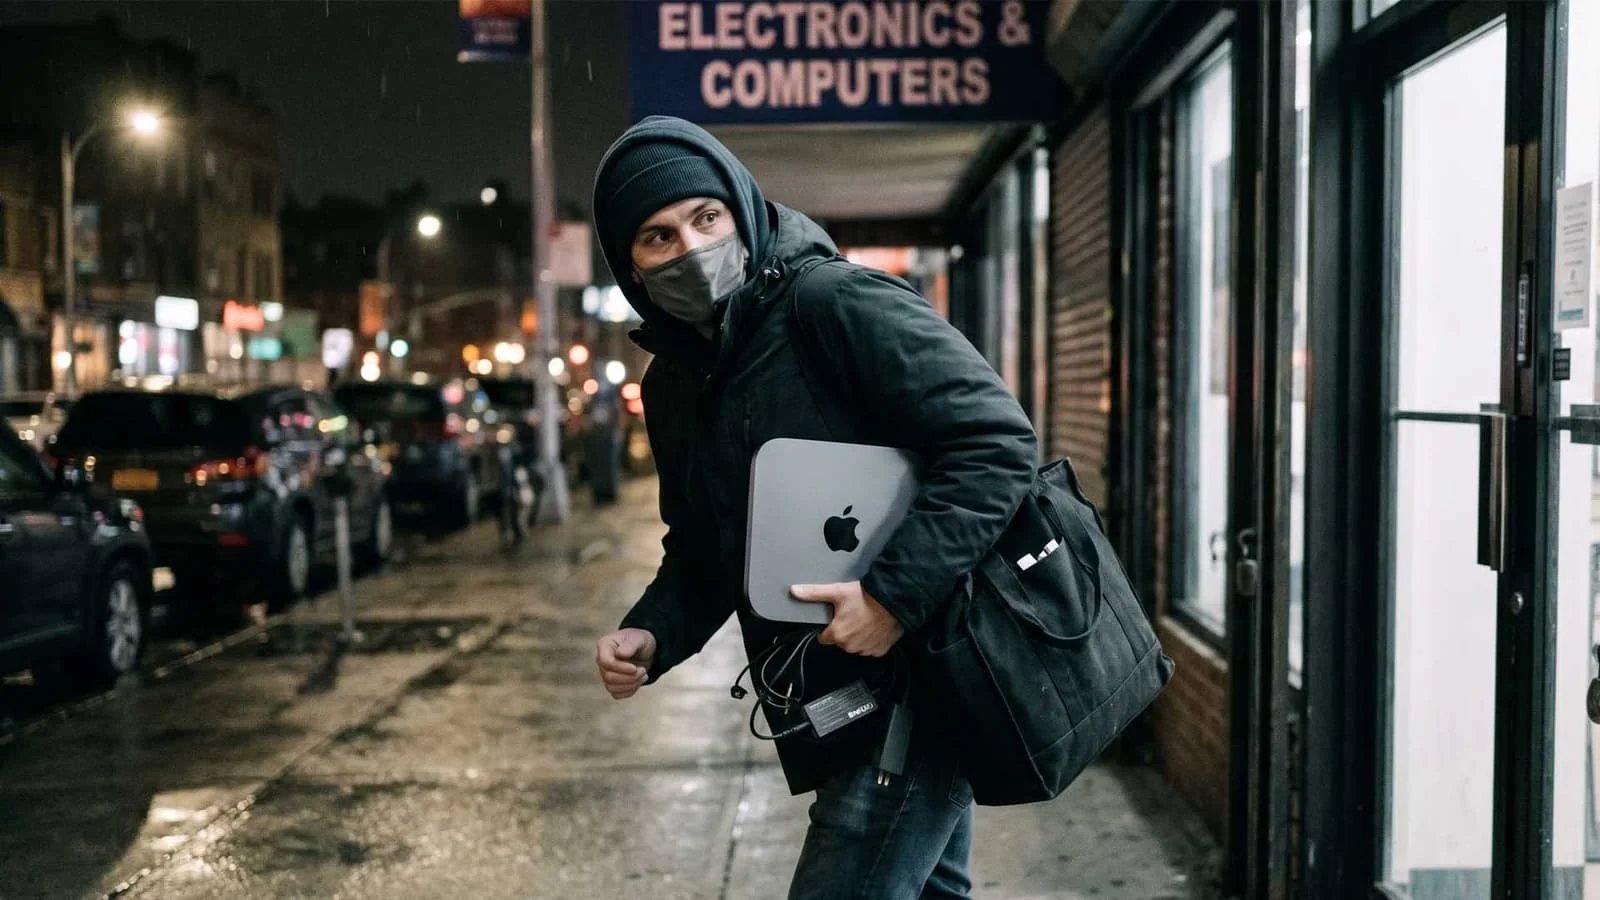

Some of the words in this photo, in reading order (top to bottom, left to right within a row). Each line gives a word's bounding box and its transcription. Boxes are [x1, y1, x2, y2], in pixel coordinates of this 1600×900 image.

[659, 1, 982, 49] ELECTRONICS
[998, 1, 1030, 46] &
[701, 58, 989, 108] COMPUTERS
